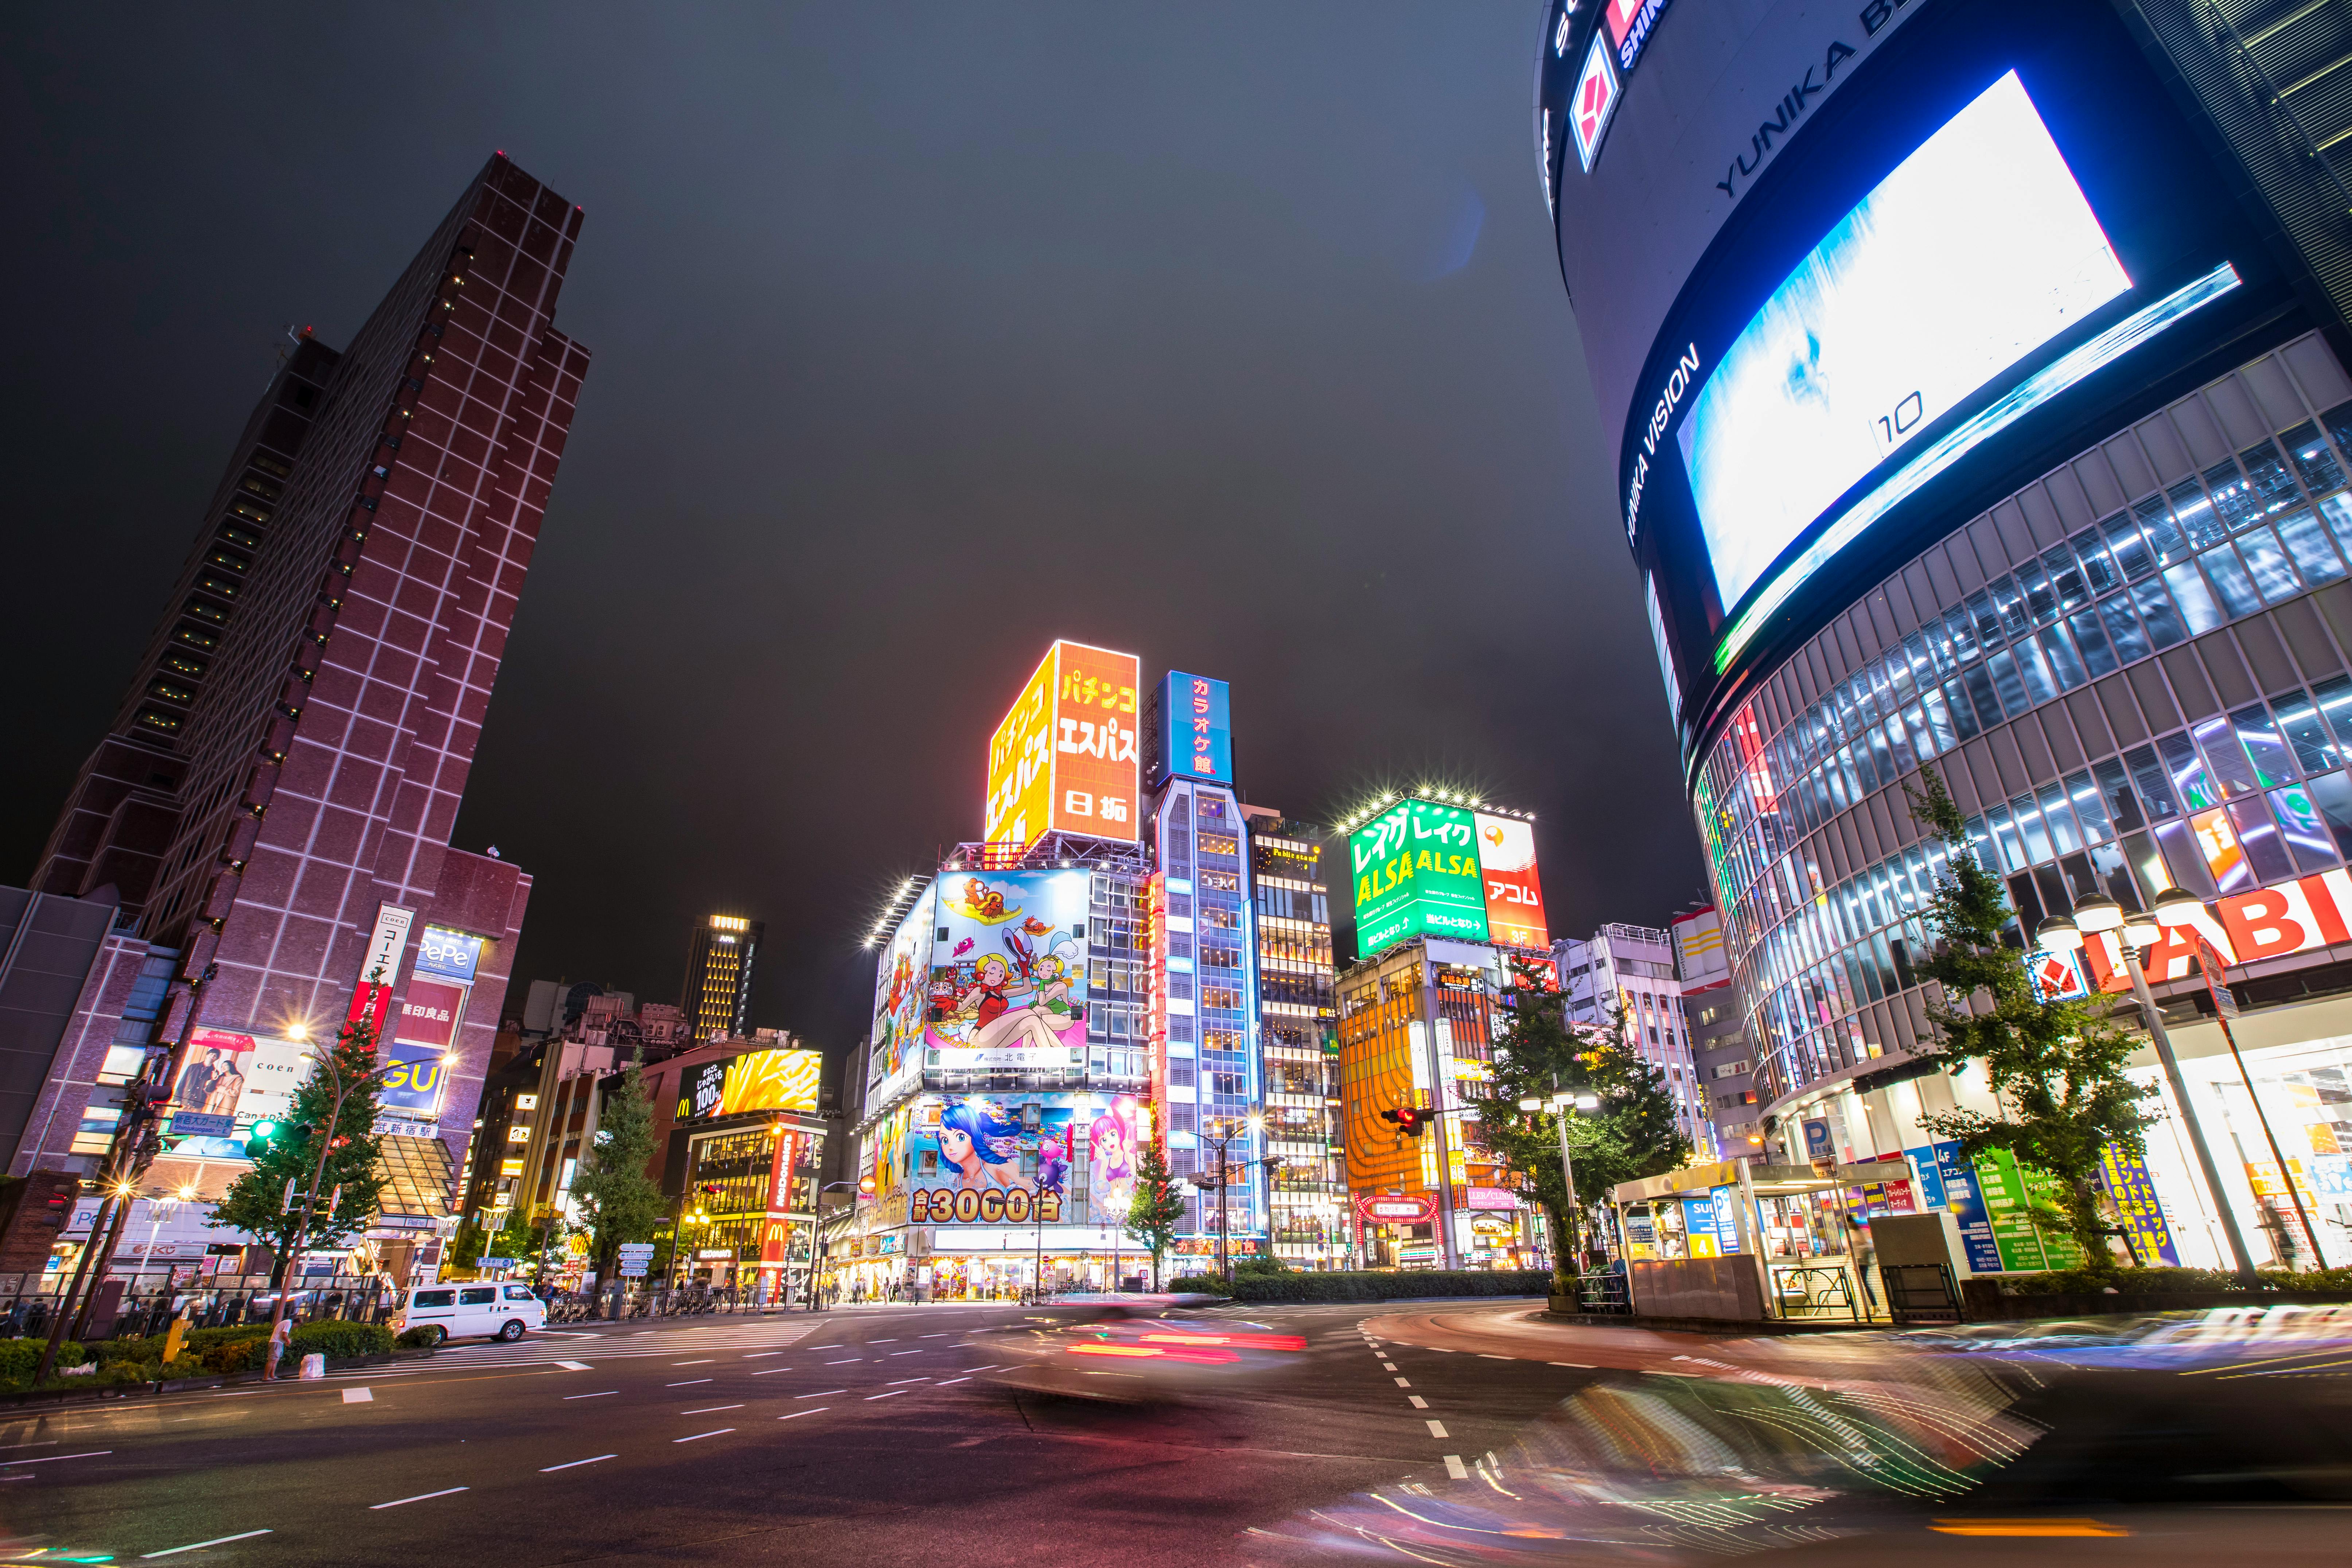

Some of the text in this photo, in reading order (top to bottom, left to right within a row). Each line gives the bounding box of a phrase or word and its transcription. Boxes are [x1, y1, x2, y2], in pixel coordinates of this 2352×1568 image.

[1716, 41, 1858, 199] YUNIKA
[1628, 342, 1699, 547] YUNIKA VISION
[1061, 669, 1136, 714] パチンコ
[994, 680, 1045, 779] パチンコ
[1193, 680, 1211, 773] カラオケ館
[1058, 717, 1137, 764] エスパス
[985, 724, 1049, 832] エスパス
[1066, 790, 1127, 822] 日拓
[1354, 814, 1407, 874] レイク
[1413, 816, 1471, 847] レイク
[1274, 848, 1318, 863] Public stand
[1416, 849, 1478, 878] ALSA
[1356, 850, 1414, 907] ALSA
[1488, 881, 1539, 906] アコム
[386, 916, 404, 925] coen
[1426, 913, 1473, 929] 当ビルとなり
[1367, 923, 1400, 948] 当ビルとなり
[1511, 930, 1527, 943] 3F
[2083, 874, 2351, 993] LABI
[419, 940, 468, 966] PePe
[1678, 946, 1687, 978] Quijote
[1149, 946, 1157, 1036] エスパス
[401, 1003, 449, 1022] 無印良品
[257, 1062, 294, 1073] coen
[1005, 1053, 1036, 1061] 北電子
[383, 1059, 438, 1092] GU
[697, 1070, 723, 1090] じゃがいも
[703, 1064, 717, 1077] まるごと
[696, 1083, 721, 1111] 100%
[175, 1114, 234, 1128] 新宿大ガード東
[237, 1111, 257, 1120] Can
[695, 1109, 705, 1118] PURE
[175, 1124, 215, 1133] Shinjukuogado
[375, 1122, 431, 1137] 武新宿駅
[1806, 1122, 1827, 1155] P
[1937, 1148, 1949, 1162] 4F
[769, 1134, 793, 1207] McDonald's
[914, 1188, 1063, 1223] 合計 3000台
[1490, 1192, 1513, 1200] CLINIC
[700, 1249, 732, 1258] McDonald's
[1178, 1239, 1256, 1254] カラケ館
[1698, 1240, 1708, 1254] 4
